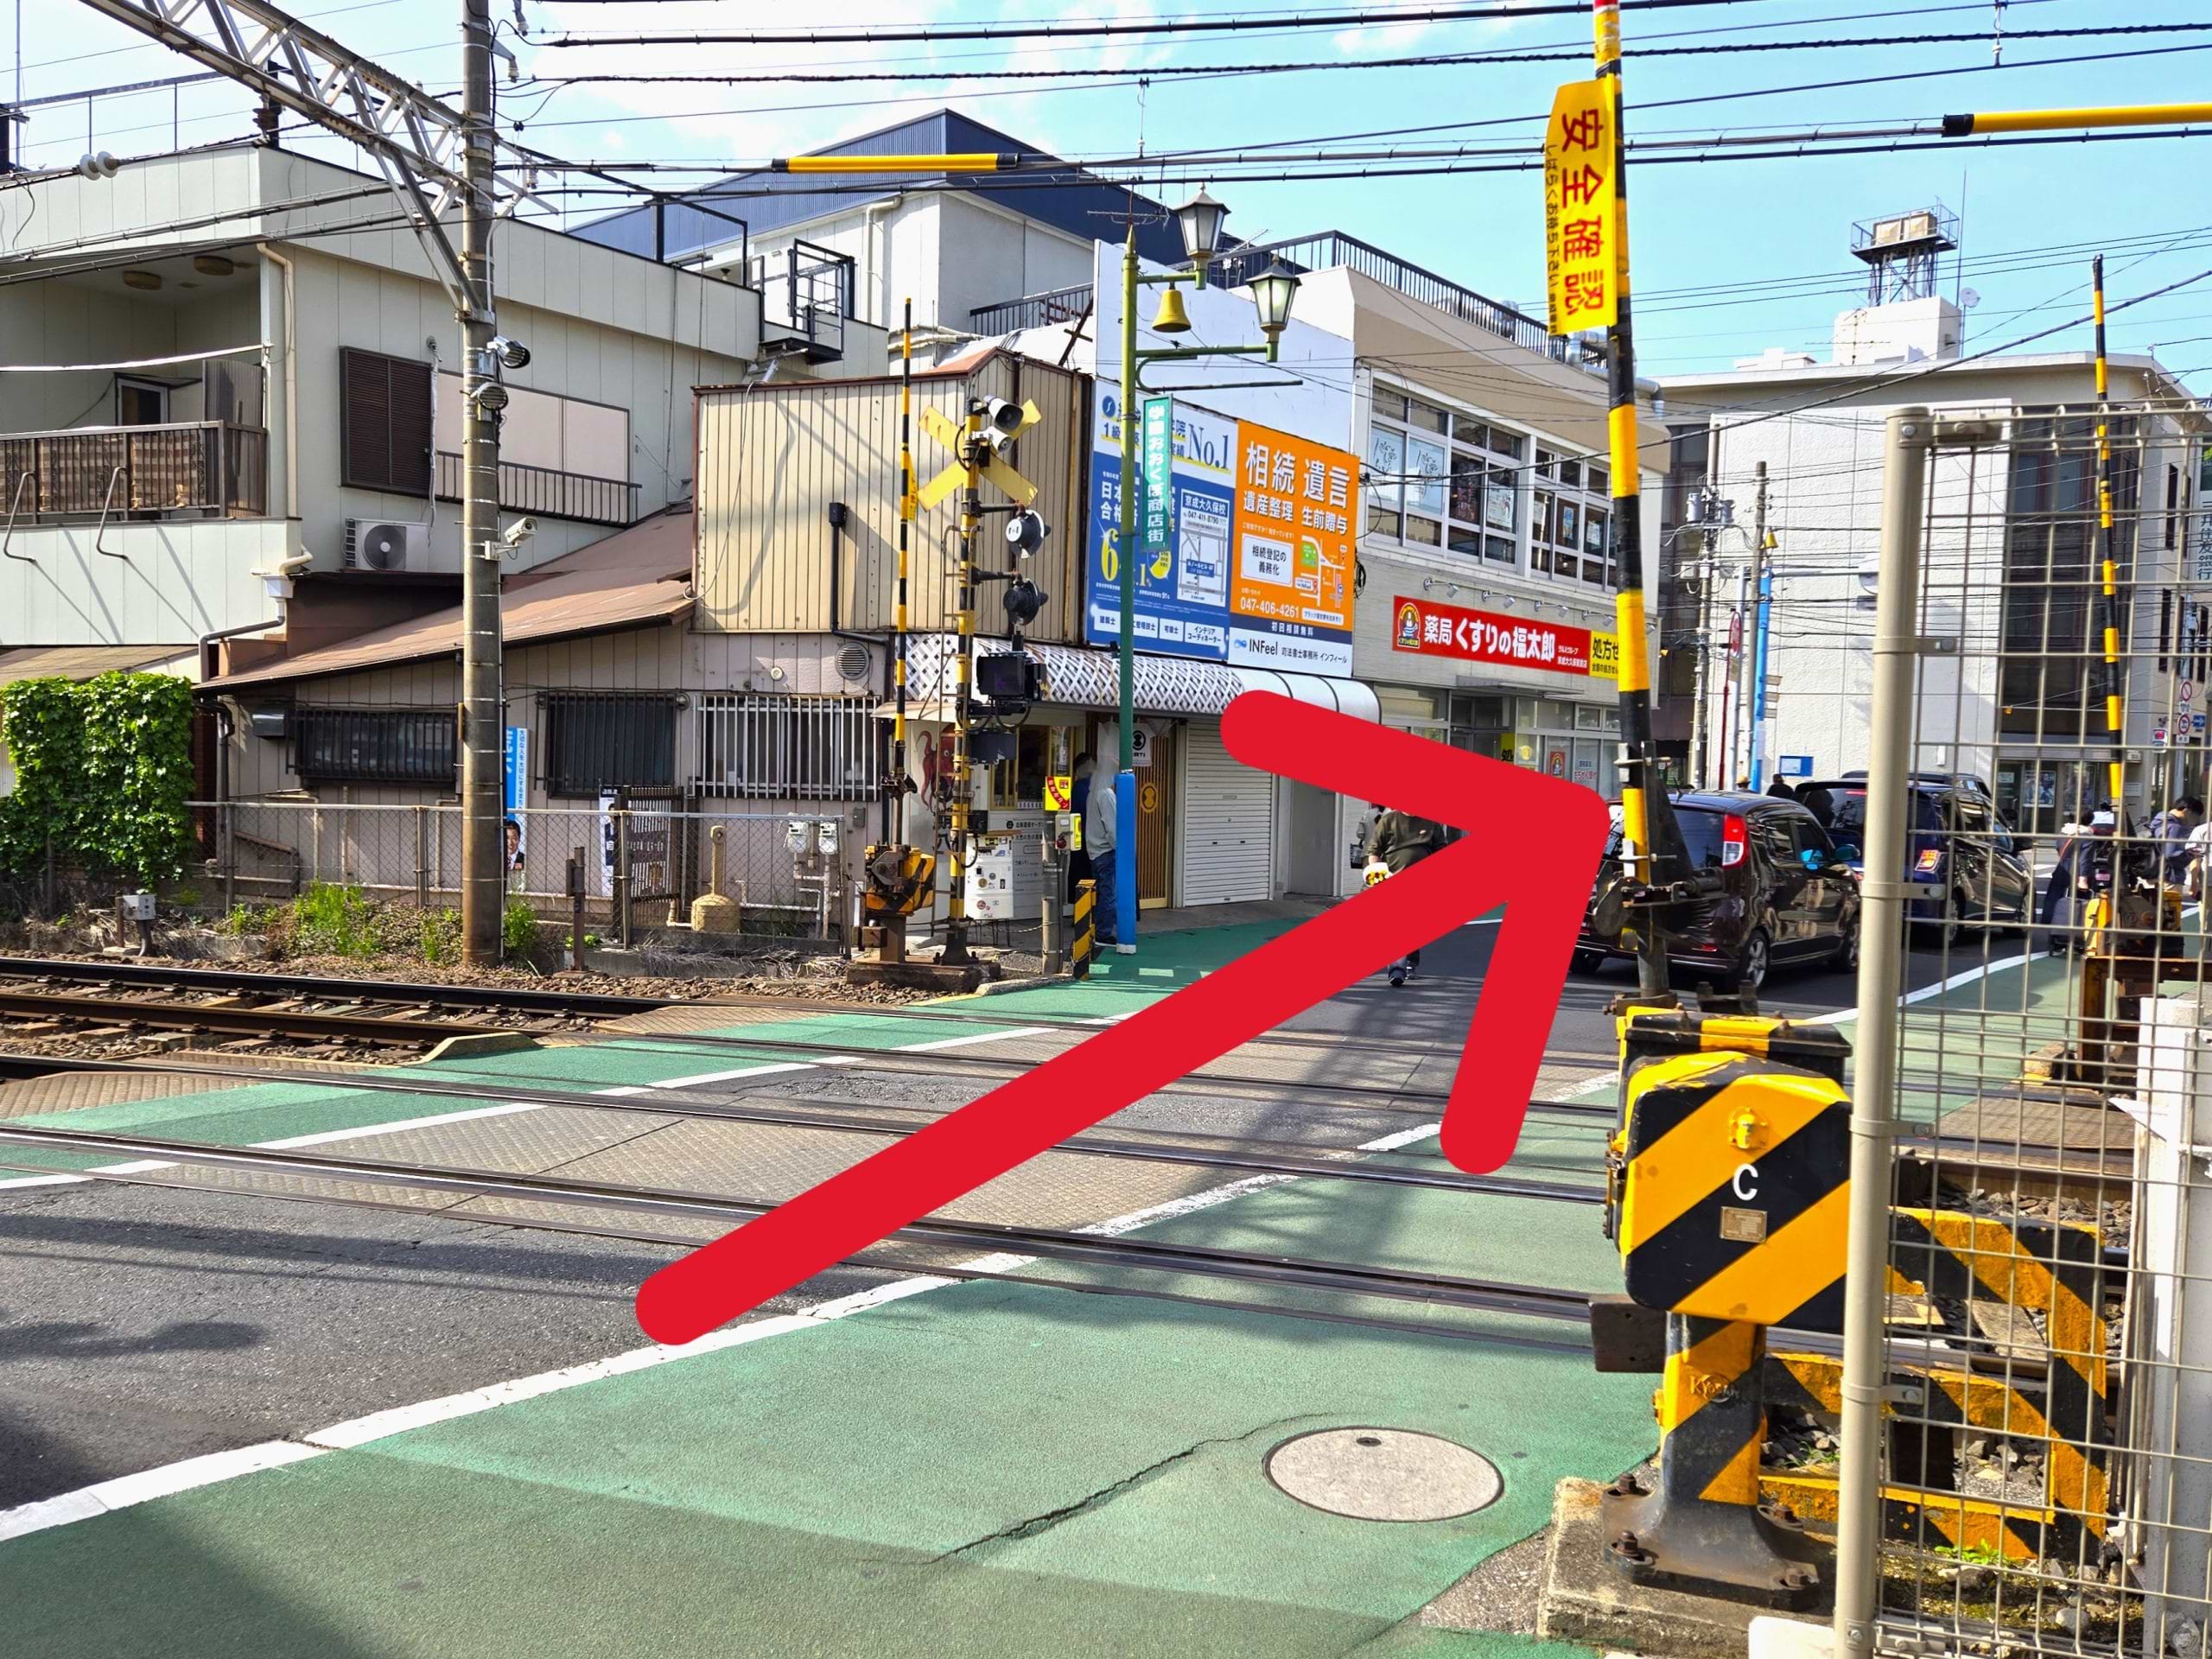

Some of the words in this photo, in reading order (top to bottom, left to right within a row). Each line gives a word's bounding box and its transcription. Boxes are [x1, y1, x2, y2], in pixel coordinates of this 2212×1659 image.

[1546, 144, 1560, 289] しばらくお待ち下さい
[1561, 109, 1604, 315] 安全確認
[1187, 423, 1230, 470] No.1
[1246, 441, 1296, 496] 相続
[1303, 458, 1351, 510] 遺言
[1243, 490, 1294, 523] 遺産整理
[1301, 505, 1348, 535] 生前贈与
[1252, 544, 1287, 563] 相続登記の
[1240, 596, 1300, 619] 047-406-4261
[1271, 621, 1314, 638] 初回相談無料
[1249, 639, 1279, 657] INFeel
[1424, 614, 1452, 645] 薬局
[1455, 618, 1555, 662] くすりの福太郎
[1733, 1163, 1758, 1200] C
